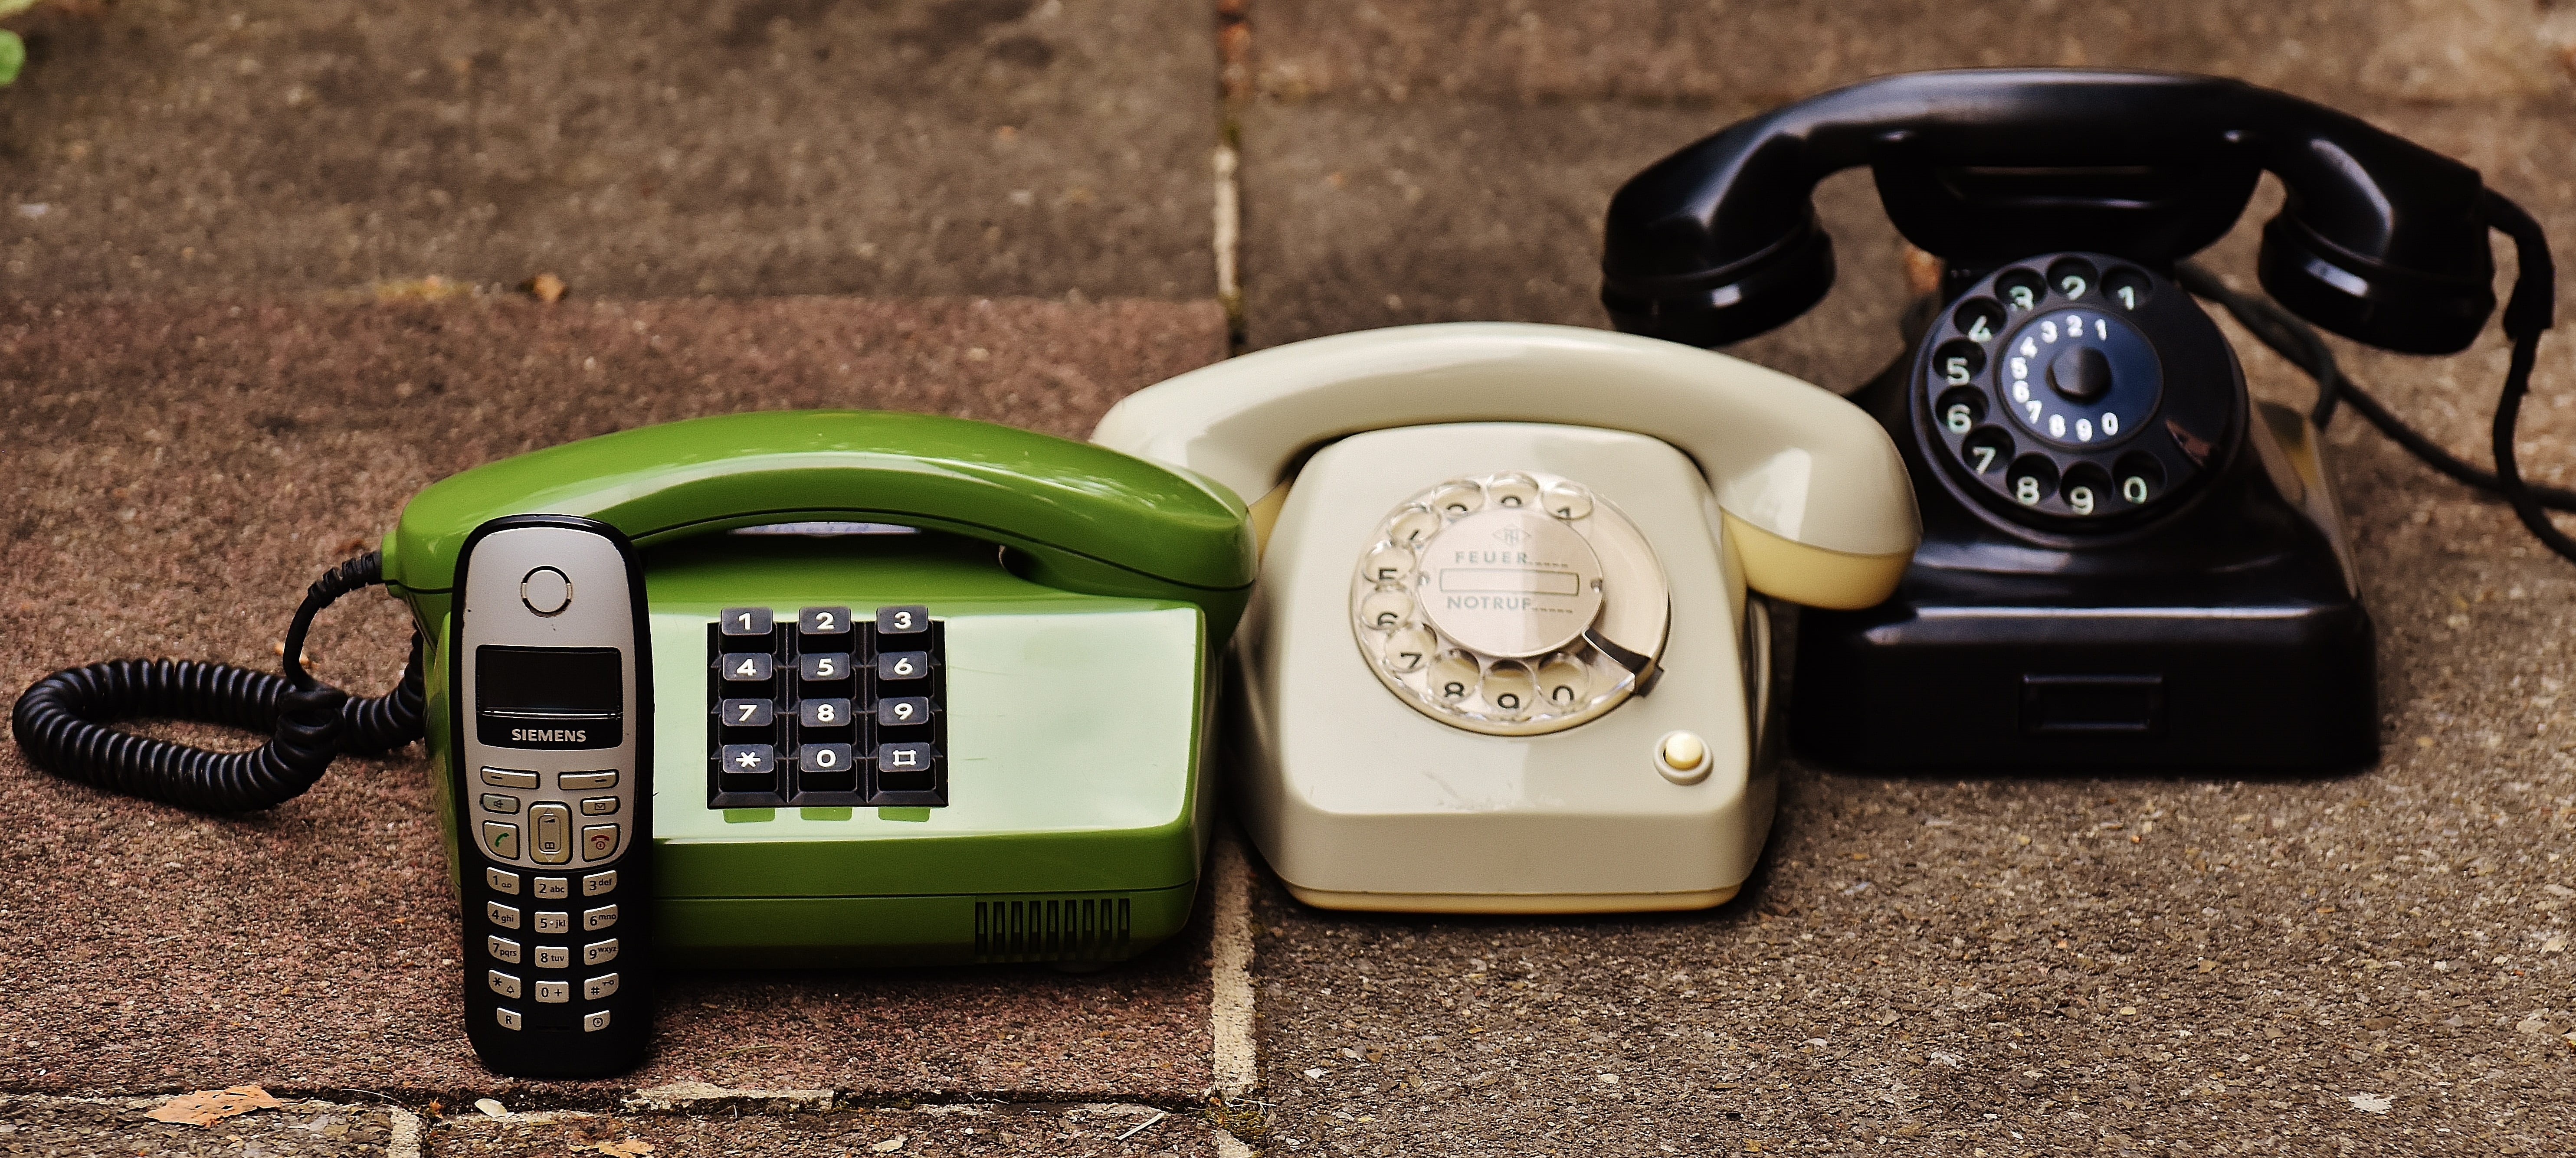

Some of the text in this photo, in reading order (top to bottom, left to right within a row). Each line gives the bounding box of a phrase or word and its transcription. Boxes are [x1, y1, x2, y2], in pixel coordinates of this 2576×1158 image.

[2117, 285, 2134, 311] 1
[1968, 315, 1992, 342] 4
[2041, 321, 2058, 343] 3
[2066, 314, 2083, 337] 2
[2094, 318, 2107, 341] 1
[2020, 336, 2038, 358] 4
[1945, 357, 1970, 386] 5
[2010, 357, 2028, 380] 5
[2012, 379, 2029, 403] 6
[1946, 403, 1972, 434] 6
[2025, 400, 2042, 424] 7
[2075, 418, 2092, 442] 9
[2101, 412, 2119, 435] 0
[1972, 446, 1996, 475] 7
[2016, 475, 2039, 506] 8
[2123, 475, 2148, 505] 0
[2070, 486, 2094, 515] 9
[1447, 596, 1531, 610] NOTRUF
[738, 612, 751, 630] 1
[816, 612, 834, 630] 2
[894, 612, 912, 629] 3
[736, 659, 756, 676] 4
[817, 658, 834, 676] 5
[894, 658, 913, 675] 6
[1400, 652, 1422, 668] 7
[1445, 681, 1465, 697] 8
[739, 704, 757, 722] 7
[817, 704, 835, 722] 8
[894, 703, 913, 720] 9
[511, 729, 587, 743] SIEMENS
[816, 749, 836, 768] 0
[492, 875, 498, 885] 1
[539, 883, 565, 894] 2 abc
[589, 878, 612, 891] 3 def
[492, 909, 514, 923] 4 ghi
[540, 918, 566, 929] 5 jkl
[590, 915, 597, 926] 6
[493, 942, 517, 958] 7 pqrs
[541, 952, 548, 963] 8
[589, 949, 597, 959] 9
[541, 987, 549, 998] 0
[505, 1015, 512, 1025] R
